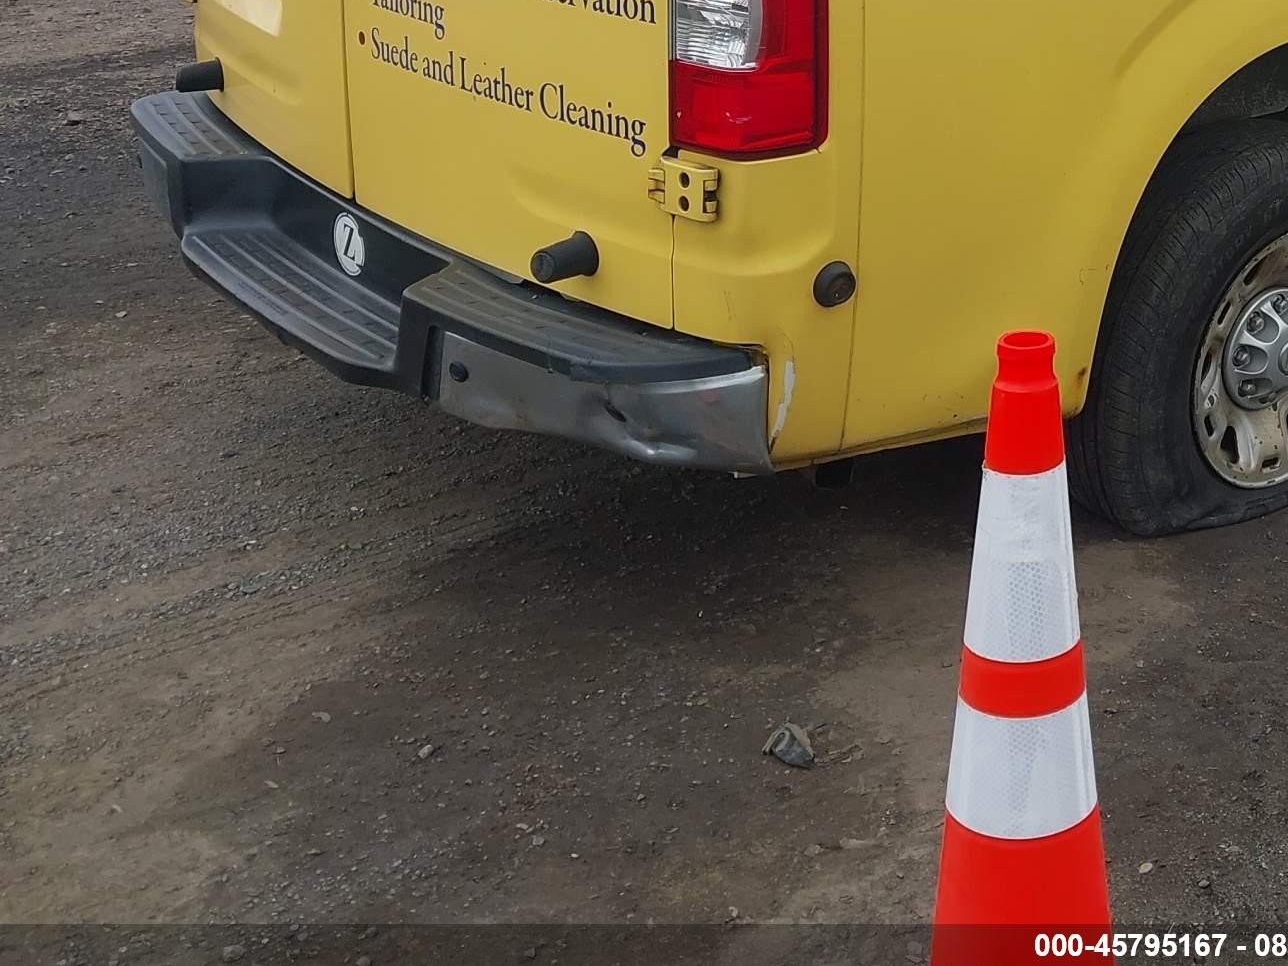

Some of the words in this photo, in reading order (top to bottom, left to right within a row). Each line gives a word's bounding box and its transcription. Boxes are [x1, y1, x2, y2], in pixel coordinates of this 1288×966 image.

[370, 27, 419, 75] Suede
[422, 51, 455, 87] and
[459, 56, 534, 113] Leather
[540, 82, 646, 157] Cleaning
